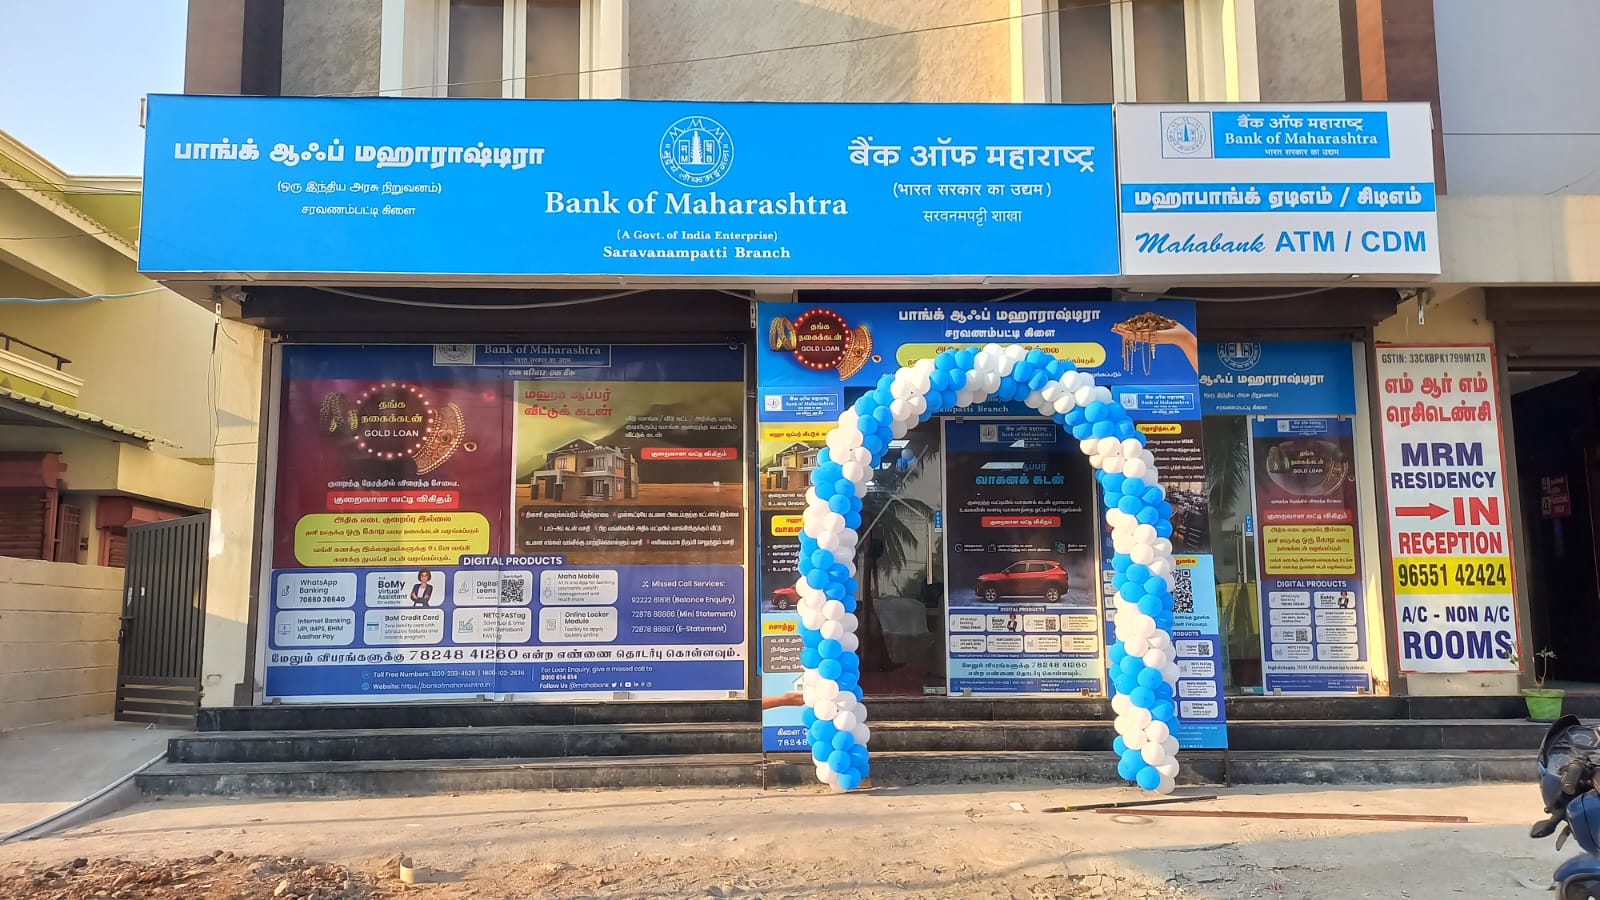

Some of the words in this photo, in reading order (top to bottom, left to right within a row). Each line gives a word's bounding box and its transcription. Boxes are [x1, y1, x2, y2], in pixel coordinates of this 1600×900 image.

[1237, 114, 1264, 129] बैंक
[1269, 114, 1303, 129] ऑफ
[1308, 116, 1363, 131] महाराष्ट्र
[1224, 132, 1265, 145] Bank
[1266, 132, 1283, 145] of
[1284, 132, 1378, 145] Maharashtra
[174, 138, 260, 161] பாங்க்
[269, 138, 344, 167] ஆஃப்
[355, 142, 544, 169] மஹாராஷ்டிரா
[847, 136, 902, 167] बैंक
[910, 137, 978, 168] ऑफ
[985, 145, 1095, 173] महाराष्ट्र
[277, 180, 301, 194] (ஒரு
[305, 181, 346, 194] இந்திய
[349, 182, 379, 194] அரசு
[382, 181, 442, 195] நிறுவனம்)
[892, 182, 931, 198] (भारत
[937, 183, 982, 196] सरकार
[987, 183, 1004, 196] का
[544, 190, 620, 214] Bank
[627, 190, 659, 214] of
[664, 192, 848, 215] Maharashtra
[1134, 186, 1261, 210] மஹாபாங்க்
[1268, 186, 1333, 210] ஏடிஎம்
[1357, 186, 1422, 206] சிடிஎம்
[301, 203, 379, 217] சரவணம்பட்டி
[381, 204, 417, 216] கிளை
[991, 209, 1023, 223] शाखा
[616, 229, 630, 241] (A
[633, 230, 664, 240] Govt.
[666, 229, 679, 240] of
[681, 230, 712, 240] India
[714, 230, 779, 242] Enterprise)
[1135, 231, 1266, 254] Mahabank
[1274, 231, 1335, 252] ATM
[1344, 231, 1352, 252] /
[1361, 230, 1427, 252] CDM
[603, 246, 727, 261] Saravanampatti
[734, 246, 791, 259] Branch
[899, 308, 945, 321] பாங்க்
[950, 308, 990, 322] ஆஃப்
[996, 308, 1101, 323] மஹாராஷ்டிரா
[945, 327, 1020, 339] சரவணம்பட்டி
[1024, 326, 1056, 338] கிளை
[485, 344, 513, 354] Bank
[516, 344, 528, 354] of
[530, 345, 601, 355] Maharashtra
[1382, 353, 1408, 364] GSTIN:
[1238, 373, 1324, 386] மஹாராஷ்டிரா
[1385, 372, 1414, 394] எம்
[1420, 372, 1452, 399] ஆர்
[1459, 370, 1488, 394] எம்
[977, 405, 1009, 413] Branch
[364, 429, 391, 437] GOLD
[393, 429, 419, 437] LOAN
[1401, 442, 1483, 467] MRM
[975, 473, 1030, 485] வாகனக்
[1033, 473, 1065, 485] கடன்
[1391, 471, 1496, 489] RESIDENCY
[1453, 496, 1500, 526] IN
[1398, 532, 1503, 554] RECEPTION
[463, 557, 504, 565] DIGITAL
[506, 556, 562, 565] PRODUCTS
[1398, 564, 1449, 587] 96551
[1455, 563, 1507, 587] 42424
[300, 579, 338, 587] WhatsApp
[377, 580, 406, 590] BoMy
[651, 579, 677, 587] Missed
[678, 579, 692, 587] Call
[705, 594, 736, 604] Enquiry)
[676, 608, 695, 618] (Mini
[695, 608, 737, 618] Statement)
[1402, 605, 1428, 623] A/C
[1445, 605, 1477, 622] NON
[1484, 604, 1511, 622] A/C
[675, 623, 727, 633] (E-Statement)
[1402, 629, 1513, 661] ROOMS
[272, 652, 313, 665] மேலும்
[317, 651, 405, 663] விபரங்களுக்கு
[408, 650, 464, 661] 78248
[470, 649, 518, 660] 41260
[522, 649, 553, 661] என்ற
[557, 649, 612, 660] எண்ணை
[616, 648, 663, 660] தொடர்பு
[666, 647, 740, 659] கொள்ளவும்.
